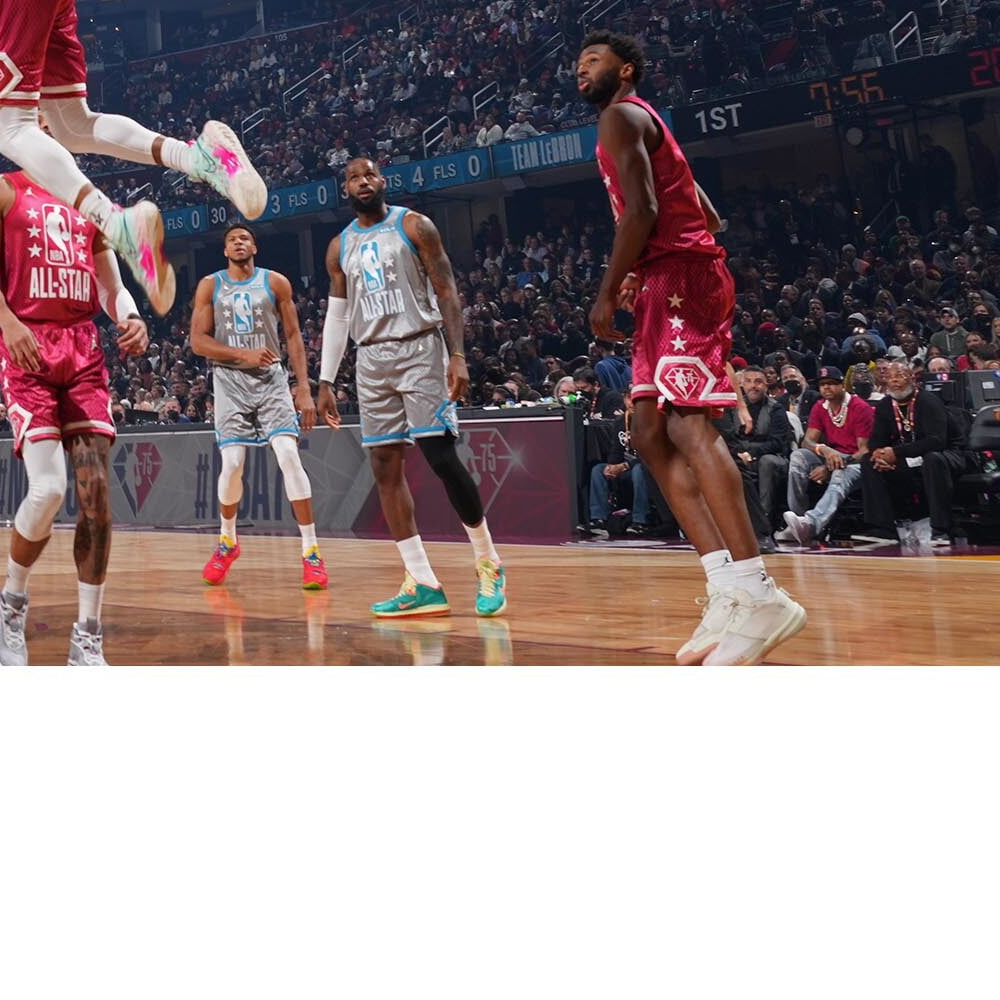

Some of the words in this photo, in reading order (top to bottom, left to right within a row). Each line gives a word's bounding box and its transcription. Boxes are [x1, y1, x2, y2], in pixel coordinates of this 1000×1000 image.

[809, 72, 885, 112] 7:56
[695, 102, 743, 134] 1ST
[412, 166, 425, 187] 4
[433, 163, 456, 180] FLS
[467, 155, 480, 177] 0
[511, 141, 538, 170] TEAM
[167, 215, 183, 230] FLS
[191, 211, 200, 230] 0
[210, 206, 227, 224] 30
[271, 197, 281, 215] 3
[288, 191, 308, 207] FLS
[317, 185, 328, 206] 0
[29, 267, 91, 302] ALL-STAR
